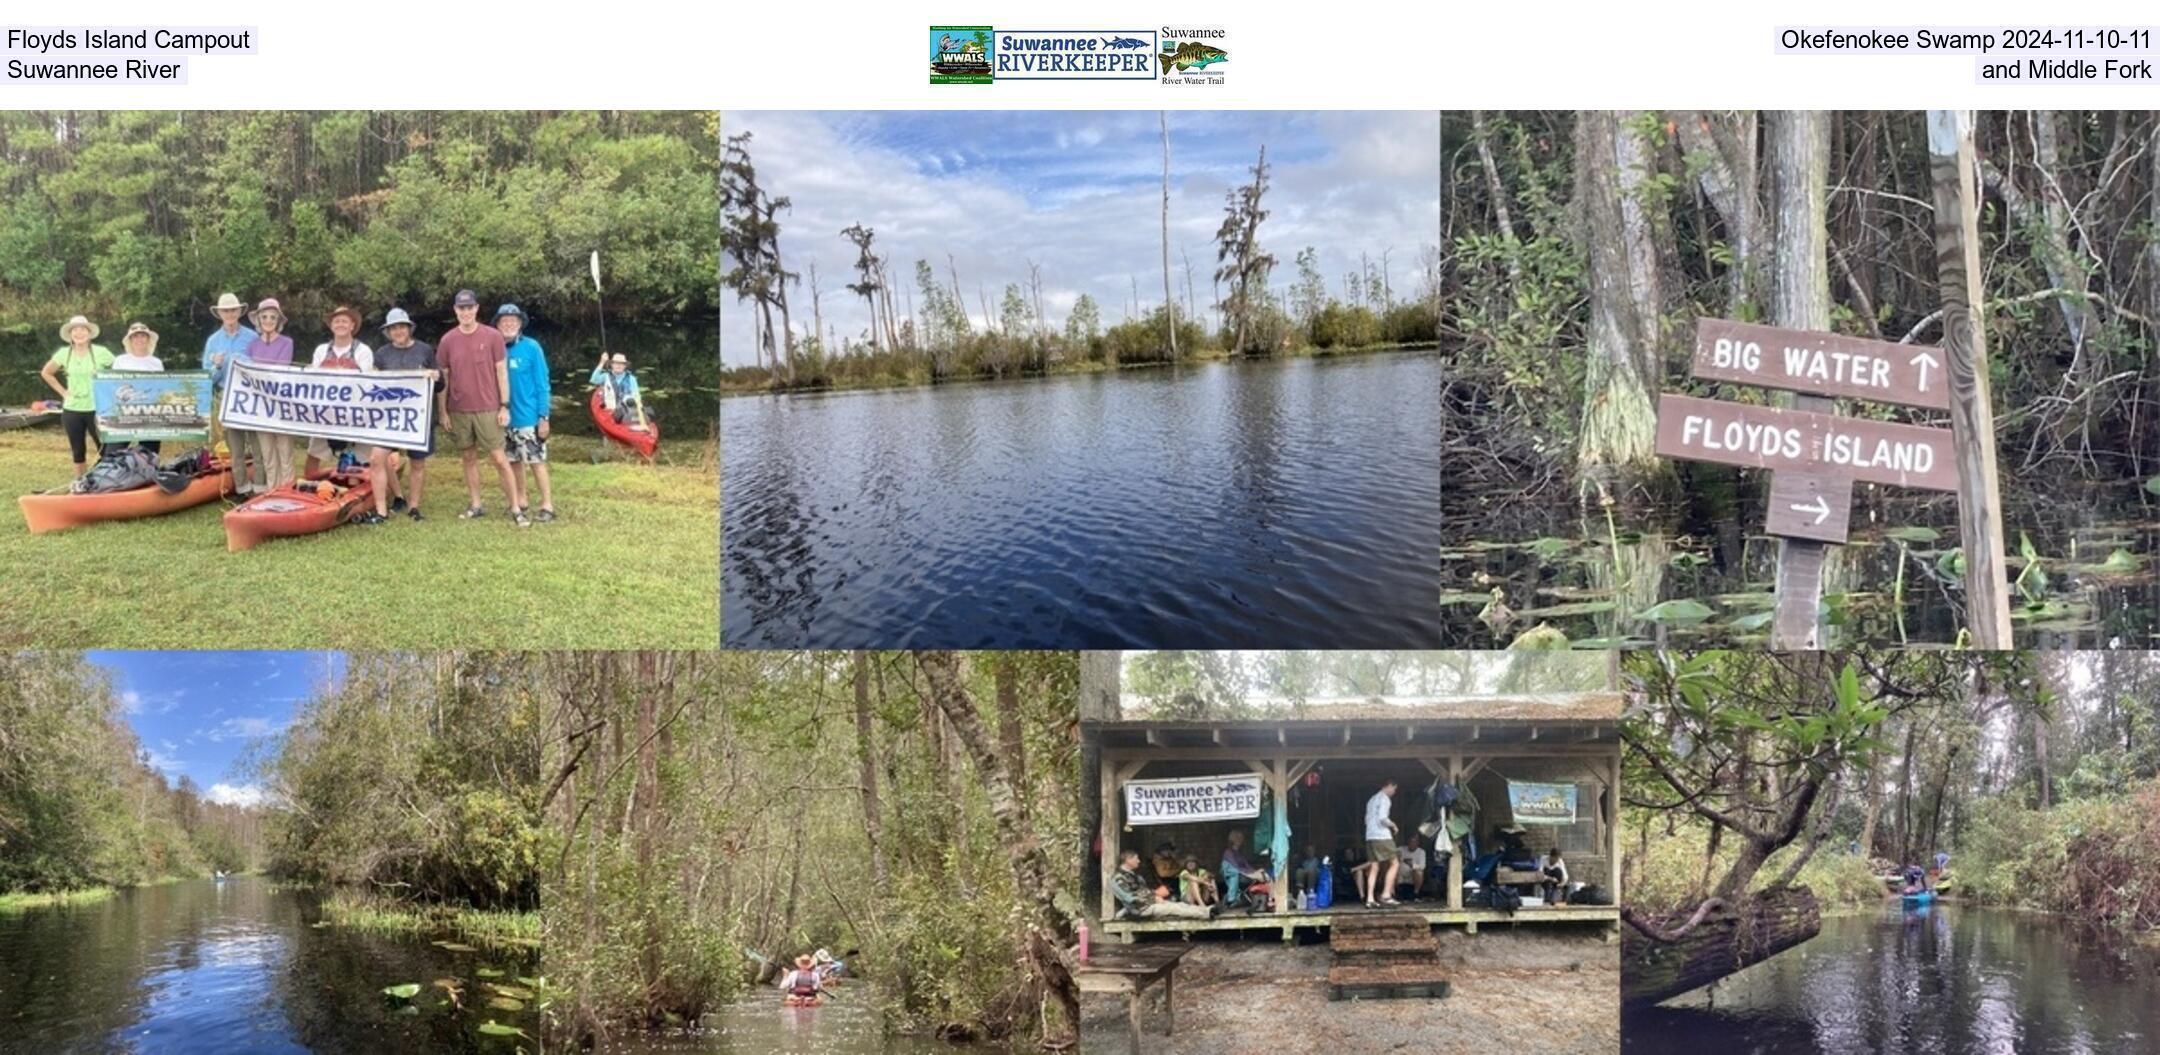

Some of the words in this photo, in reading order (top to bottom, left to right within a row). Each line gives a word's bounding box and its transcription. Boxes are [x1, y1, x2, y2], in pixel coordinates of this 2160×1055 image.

[1713, 338, 1761, 372] BIG
[1784, 346, 1890, 388] WATER
[240, 370, 353, 401] Suwannee
[121, 404, 196, 416] WWALS
[230, 389, 419, 433] RIVERKEEPER
[1682, 415, 1802, 459] FLOYDS
[1823, 432, 1933, 473] ISLAND
[1130, 795, 1256, 816] RIVERKEEPER
[1134, 785, 1214, 799] Suwannee
